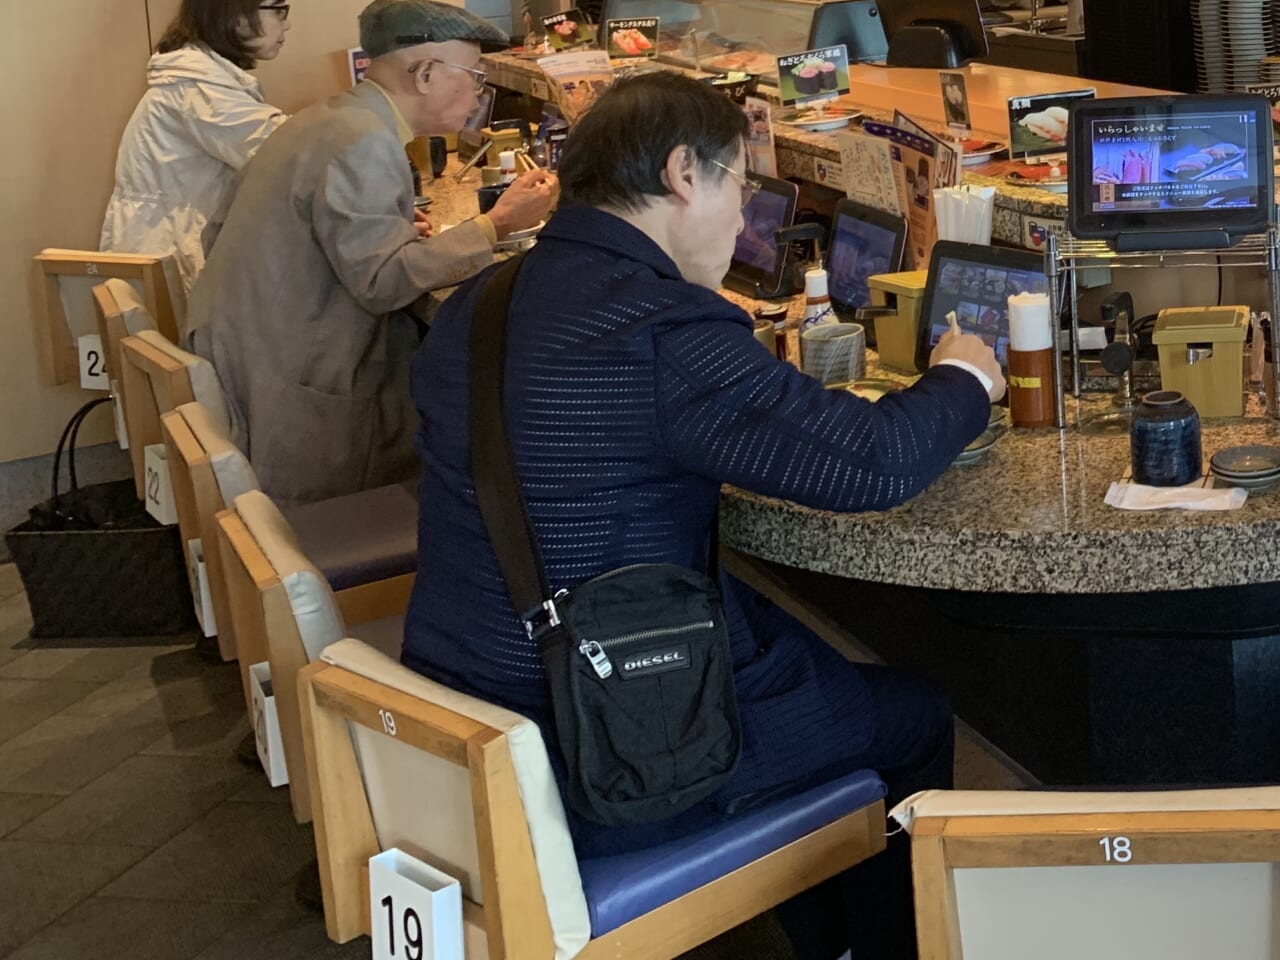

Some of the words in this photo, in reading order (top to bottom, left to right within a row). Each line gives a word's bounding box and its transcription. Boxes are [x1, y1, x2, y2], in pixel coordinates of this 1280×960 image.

[1098, 123, 1166, 134] いらっしゃいませ
[147, 467, 161, 506] 22
[624, 651, 685, 671] DIESEL
[378, 709, 397, 736] 19
[1099, 836, 1132, 863] 18
[381, 895, 423, 960] 19
